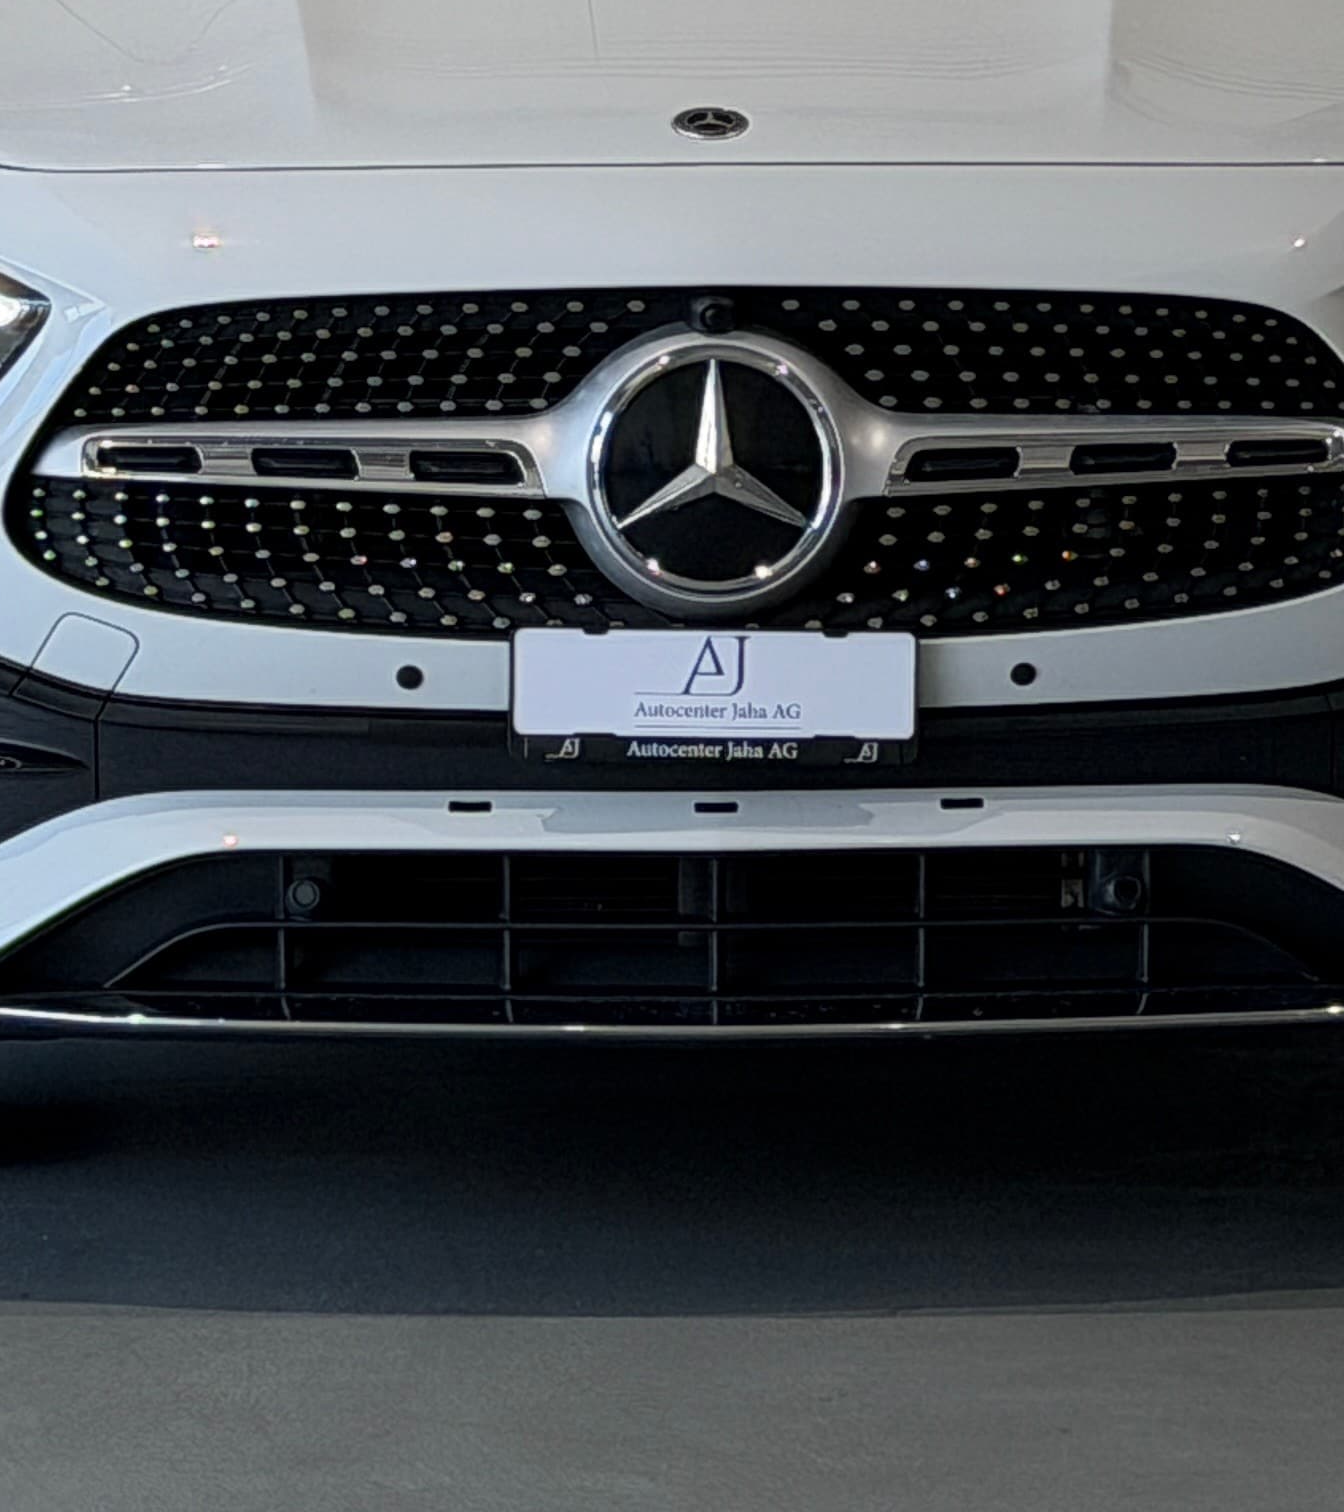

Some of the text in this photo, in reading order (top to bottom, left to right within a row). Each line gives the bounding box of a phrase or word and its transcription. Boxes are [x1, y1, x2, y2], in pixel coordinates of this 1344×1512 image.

[681, 635, 750, 696] AJ
[634, 702, 801, 721] Autocenter Jaha AG
[627, 741, 798, 760] Autocenter Jaha AG
